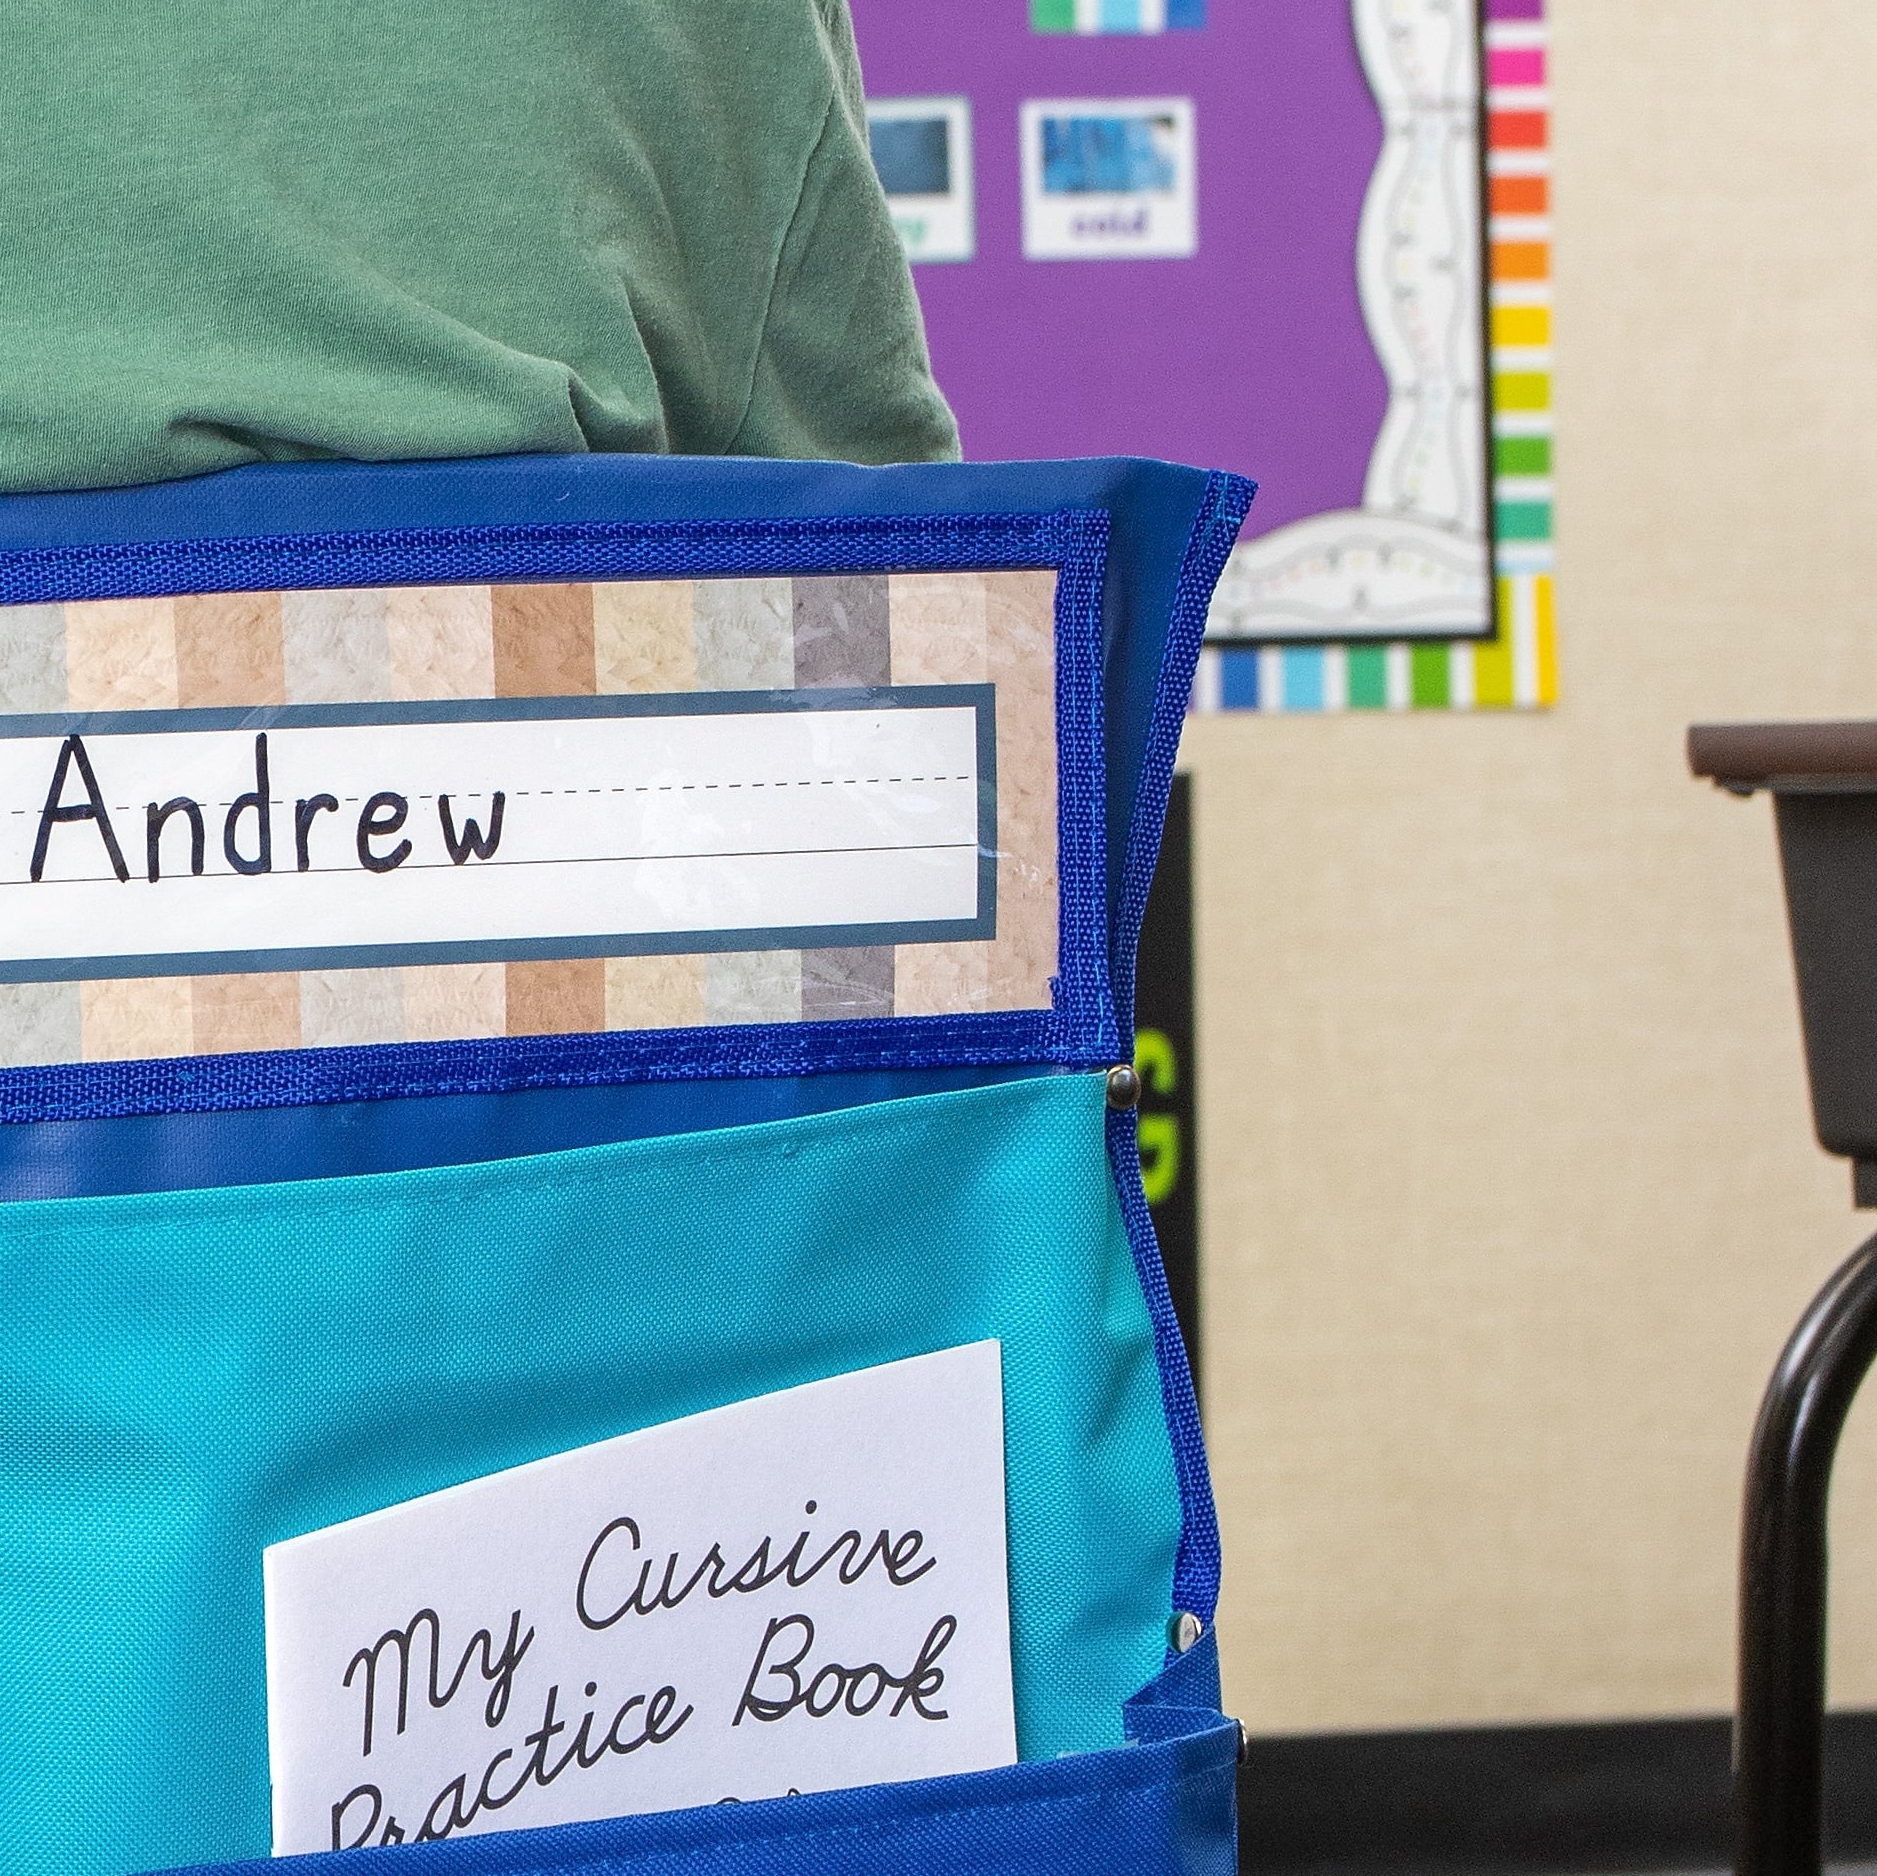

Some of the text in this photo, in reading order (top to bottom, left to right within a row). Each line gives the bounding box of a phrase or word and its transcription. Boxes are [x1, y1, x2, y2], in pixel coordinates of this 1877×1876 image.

[30, 732, 506, 883] Andrew
[343, 1500, 937, 1758] My Cursive
[732, 1614, 958, 1728] Book
